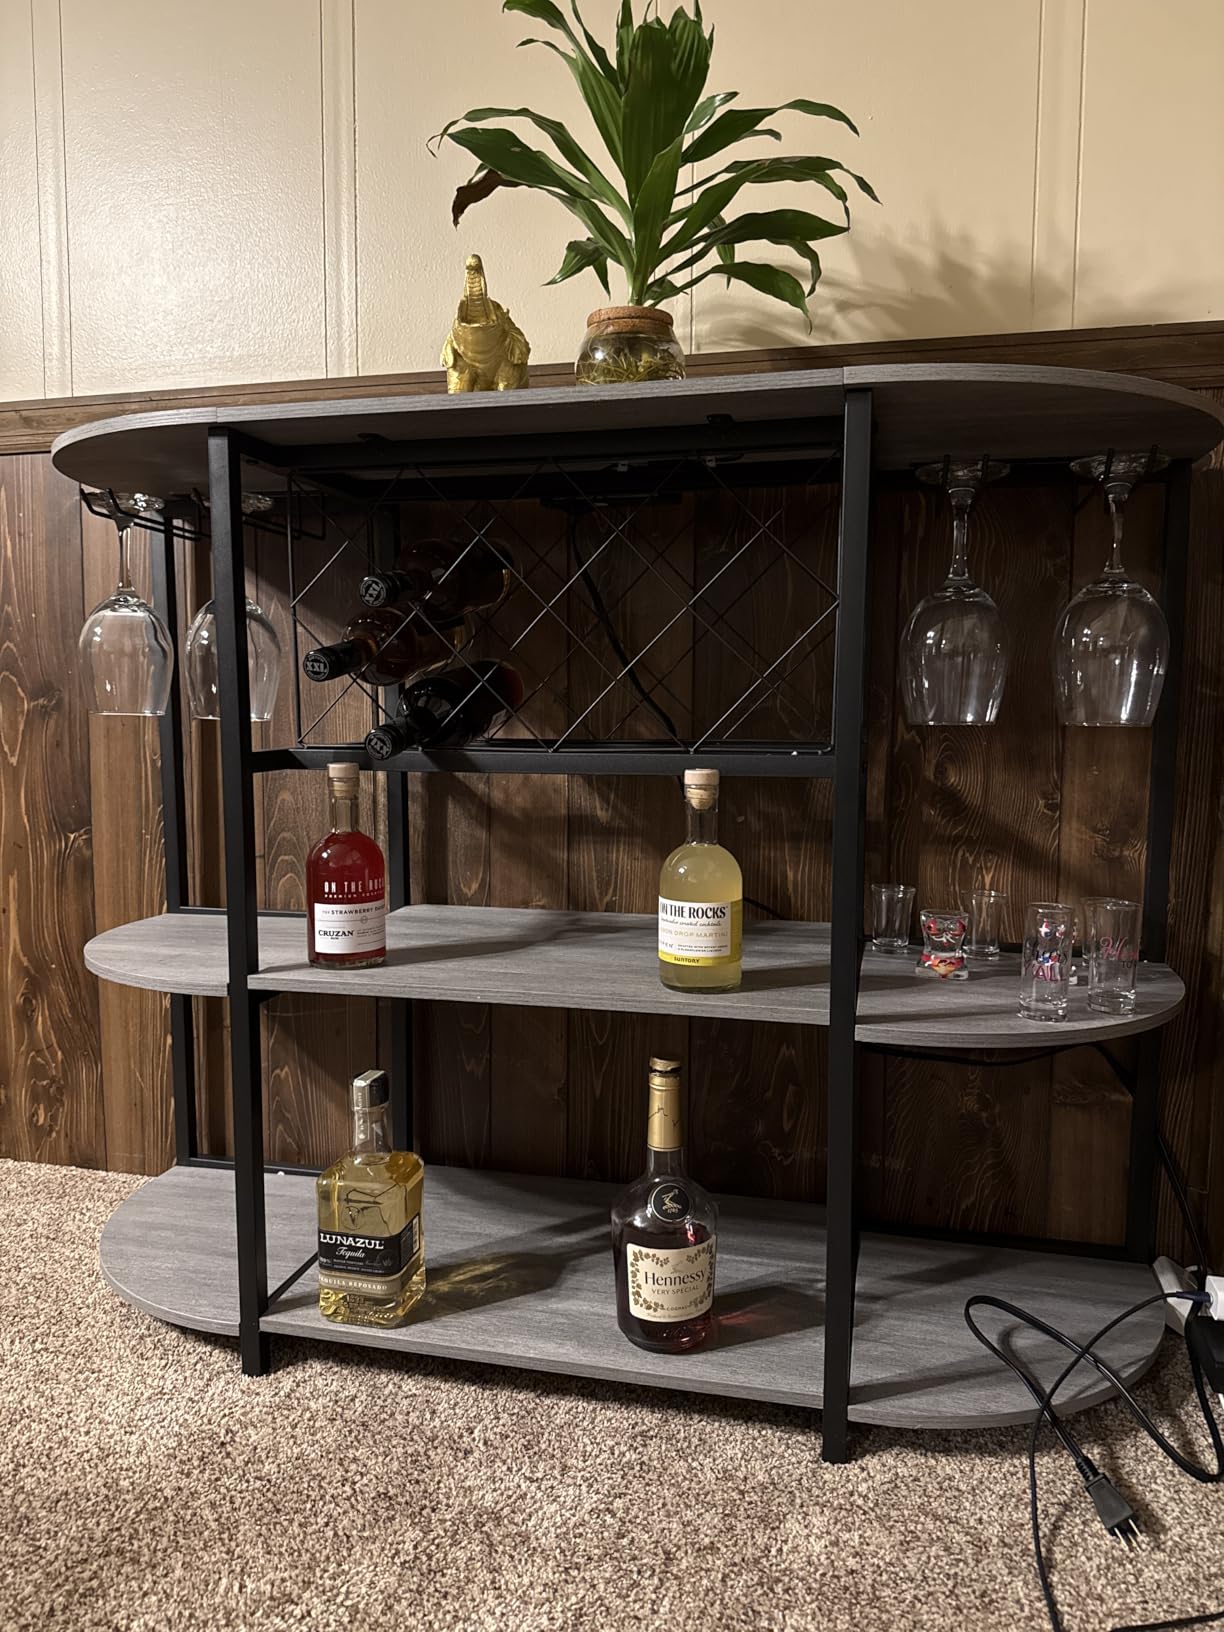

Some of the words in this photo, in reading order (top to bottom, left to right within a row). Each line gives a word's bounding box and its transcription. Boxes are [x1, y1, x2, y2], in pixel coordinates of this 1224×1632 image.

[305, 661, 328, 673] XXL
[324, 881, 337, 893] ON
[343, 880, 363, 892] THE
[330, 907, 374, 916] STRAWBERRY
[669, 903, 687, 919] THE
[688, 905, 726, 920] ROCKS
[318, 929, 354, 937] CRUZAN
[696, 930, 729, 939] MARTINI
[319, 1232, 385, 1250] LUNAZUL
[335, 1247, 365, 1260] Tequila
[644, 1269, 705, 1286] Hennessy
[348, 1280, 388, 1291] REPOSADO
[671, 1284, 700, 1295] SPECIAL
